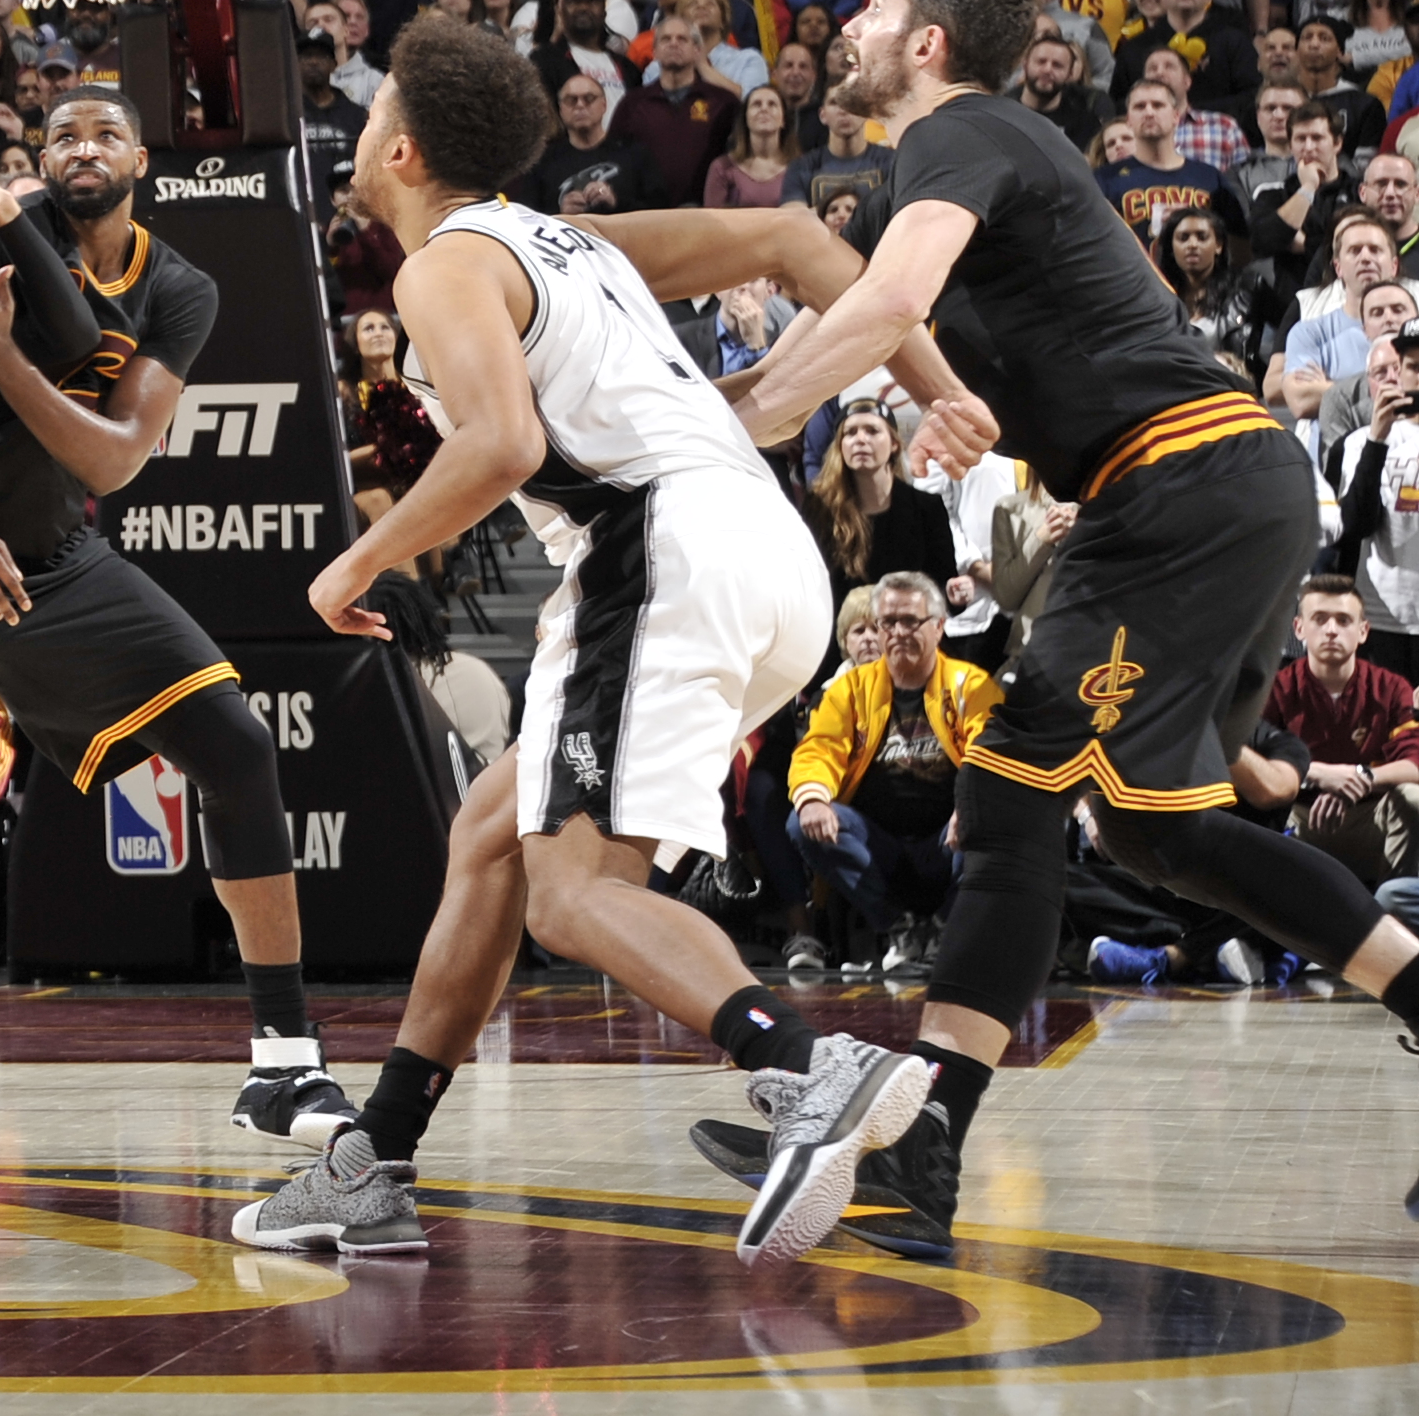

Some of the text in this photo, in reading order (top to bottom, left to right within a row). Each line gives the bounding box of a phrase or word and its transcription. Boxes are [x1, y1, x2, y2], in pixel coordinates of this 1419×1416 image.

[155, 172, 266, 204] SPALDING
[120, 503, 323, 551] #NBAFIT
[277, 690, 315, 750] IS
[117, 836, 163, 860] NBA
